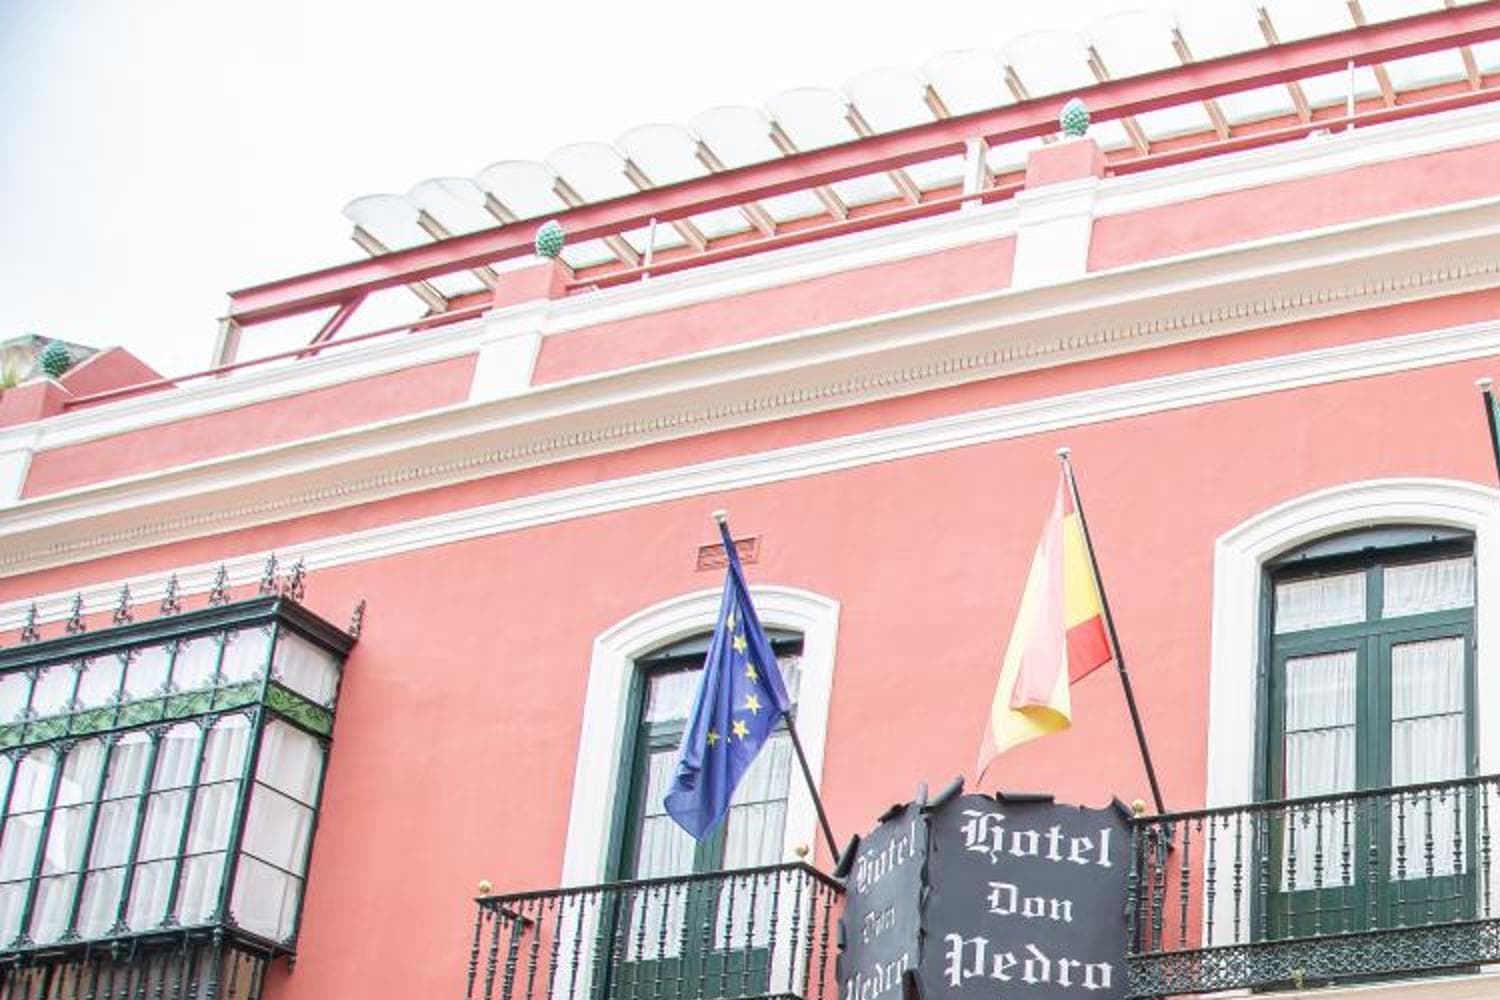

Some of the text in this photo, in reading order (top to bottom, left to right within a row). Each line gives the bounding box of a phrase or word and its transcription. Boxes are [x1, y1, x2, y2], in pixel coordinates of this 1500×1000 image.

[960, 809, 1112, 868] Hotel
[986, 881, 1073, 923] Don
[944, 933, 1113, 991] Pedro
